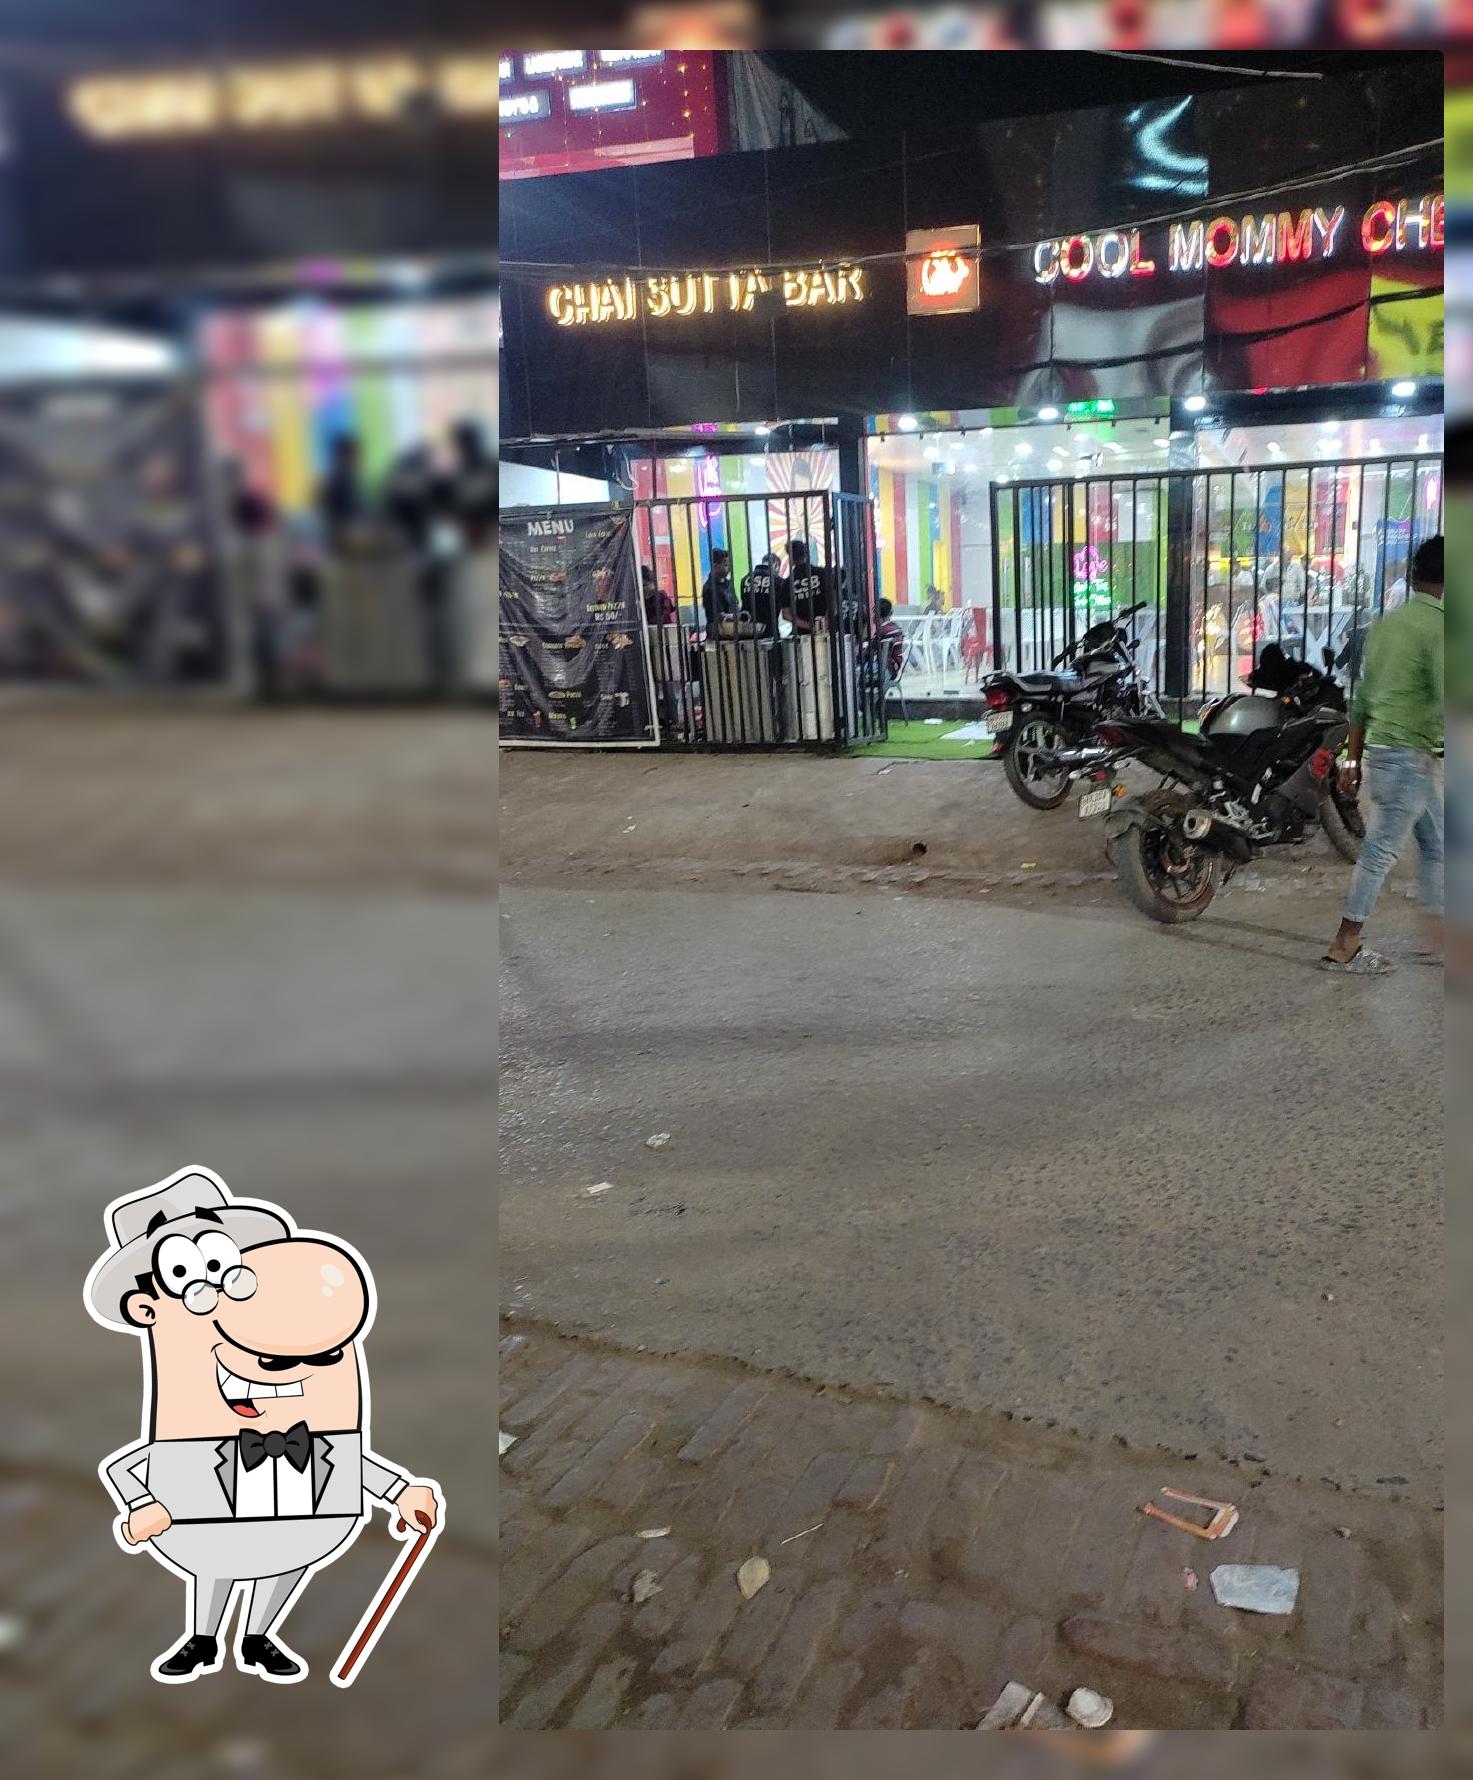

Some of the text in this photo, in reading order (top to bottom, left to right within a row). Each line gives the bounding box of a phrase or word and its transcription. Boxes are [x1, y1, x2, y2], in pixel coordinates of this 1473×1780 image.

[1033, 227, 1156, 285] COOL
[1168, 203, 1346, 273] MOMMY
[548, 277, 638, 326] CHAI
[783, 262, 866, 308] BAR
[527, 519, 574, 536] MENU
